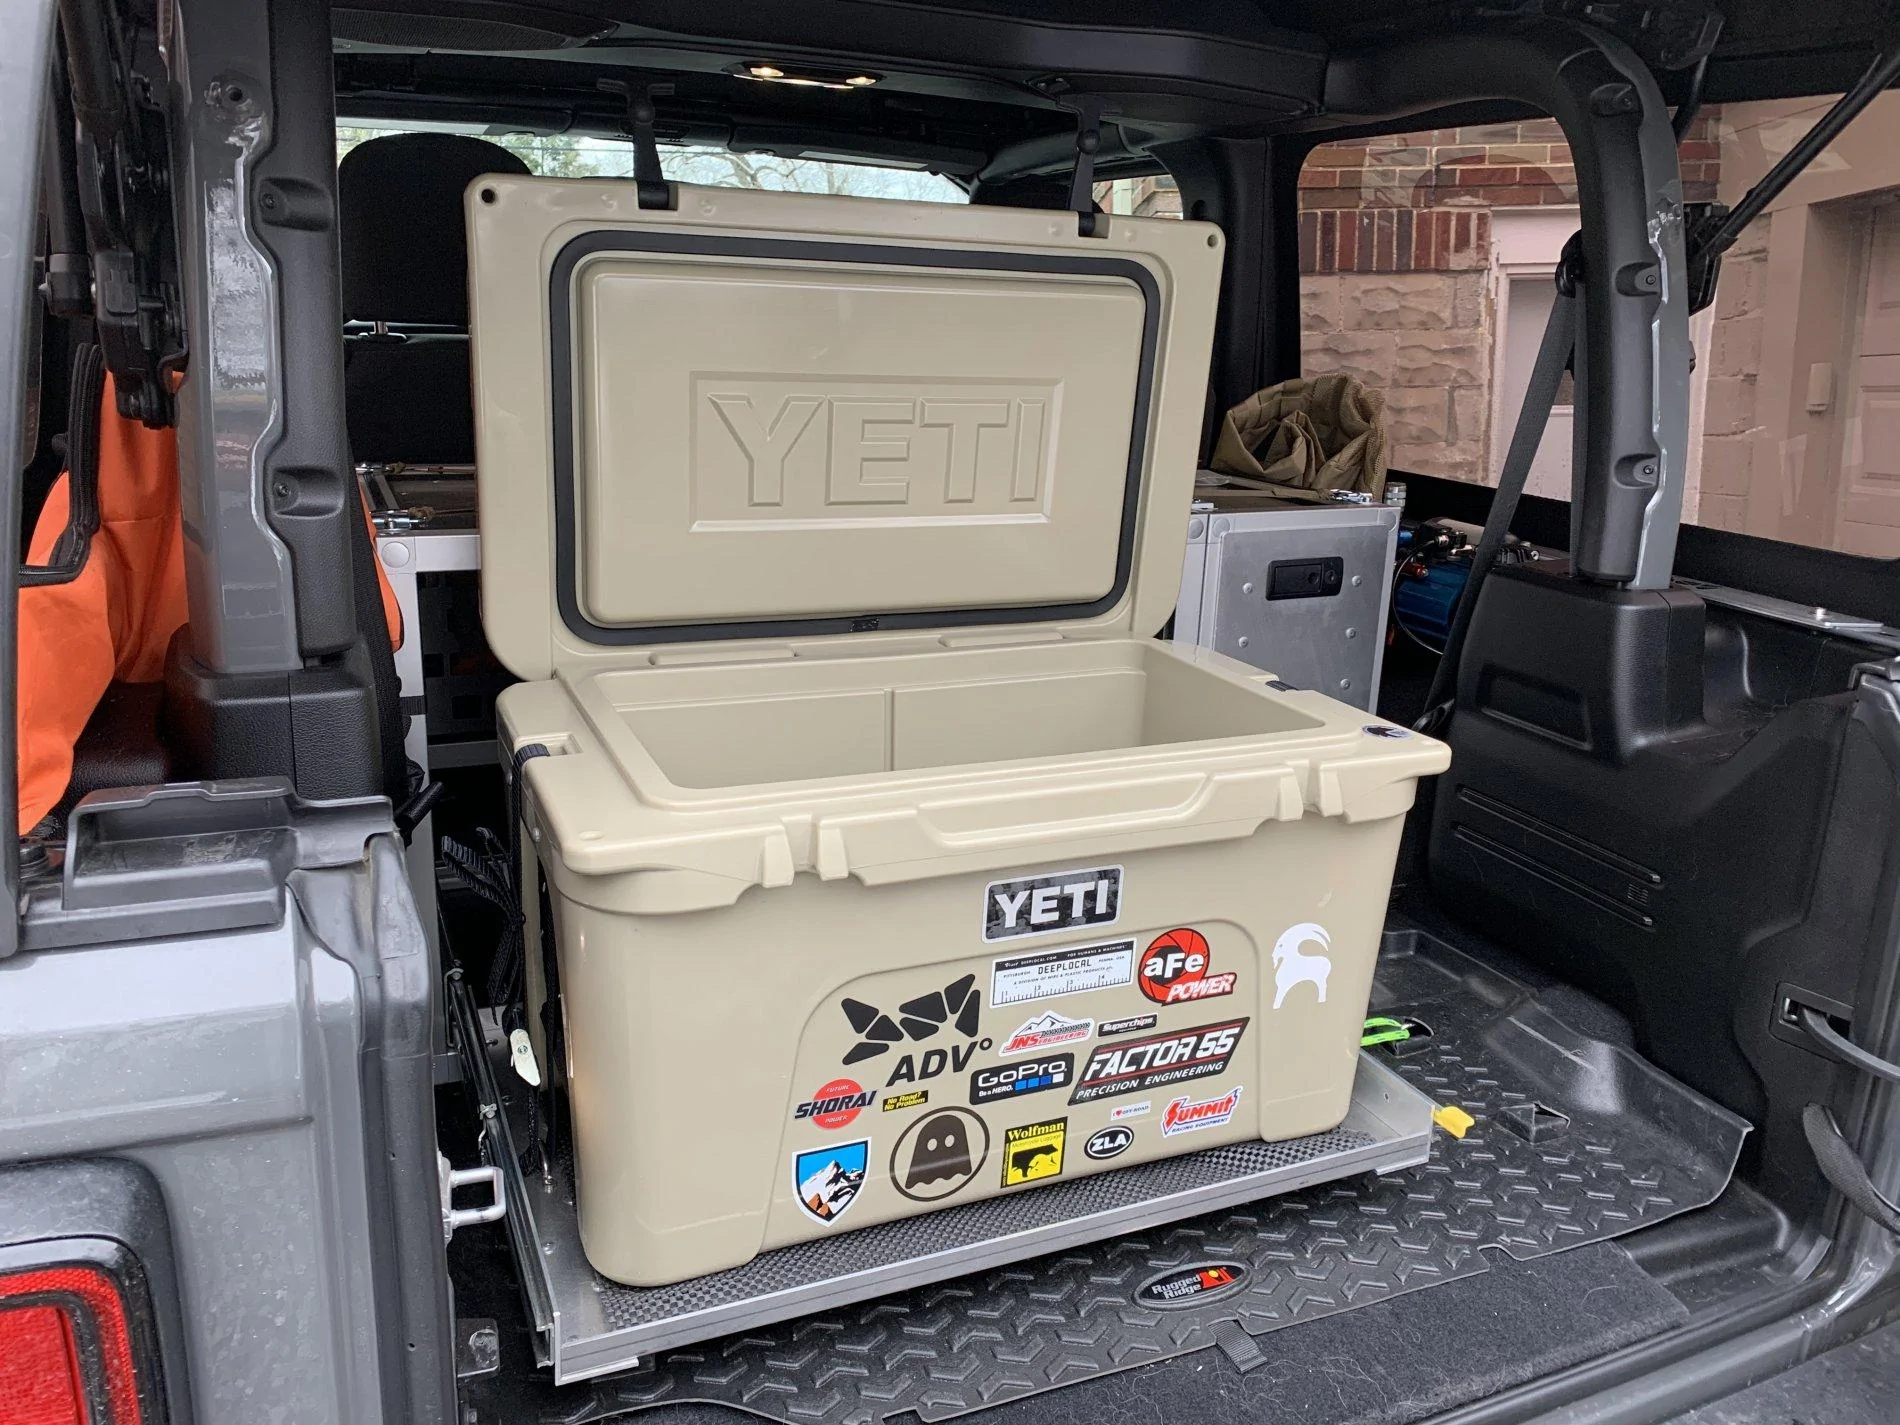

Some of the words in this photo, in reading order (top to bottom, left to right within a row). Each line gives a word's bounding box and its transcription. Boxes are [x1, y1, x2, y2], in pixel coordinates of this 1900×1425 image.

[705, 393, 1047, 507] YETI
[994, 879, 1109, 929] YETI
[1038, 958, 1091, 975] DEEPLOCAL
[1143, 952, 1204, 978] aFe
[1165, 974, 1236, 1004] POWER
[1006, 1033, 1041, 1051] JNS
[1038, 1029, 1089, 1045] ENGINEERING
[1084, 1036, 1197, 1081] FACTOR
[1195, 1026, 1240, 1059] 55
[977, 1060, 1067, 1088] GoPro
[1076, 1078, 1139, 1100] PRECISION
[1145, 1061, 1224, 1086] ENGINEERING
[826, 1084, 851, 1093] FUTURE
[888, 1096, 898, 1104] No
[899, 1091, 922, 1102] Road?
[794, 1090, 878, 1119] SHORAI
[884, 1103, 894, 1111] No
[895, 1097, 926, 1109] Problem
[825, 1115, 848, 1124] POWER
[1171, 1124, 1194, 1133] RACING
[1195, 1117, 1229, 1128] EQUIPMENT
[1008, 1122, 1065, 1141] Wolfman
[1040, 1133, 1062, 1144] Luggage
[1091, 1133, 1128, 1152] ZLA
[1151, 1274, 1202, 1295] Rugged
[1163, 1284, 1202, 1299] Ridge
